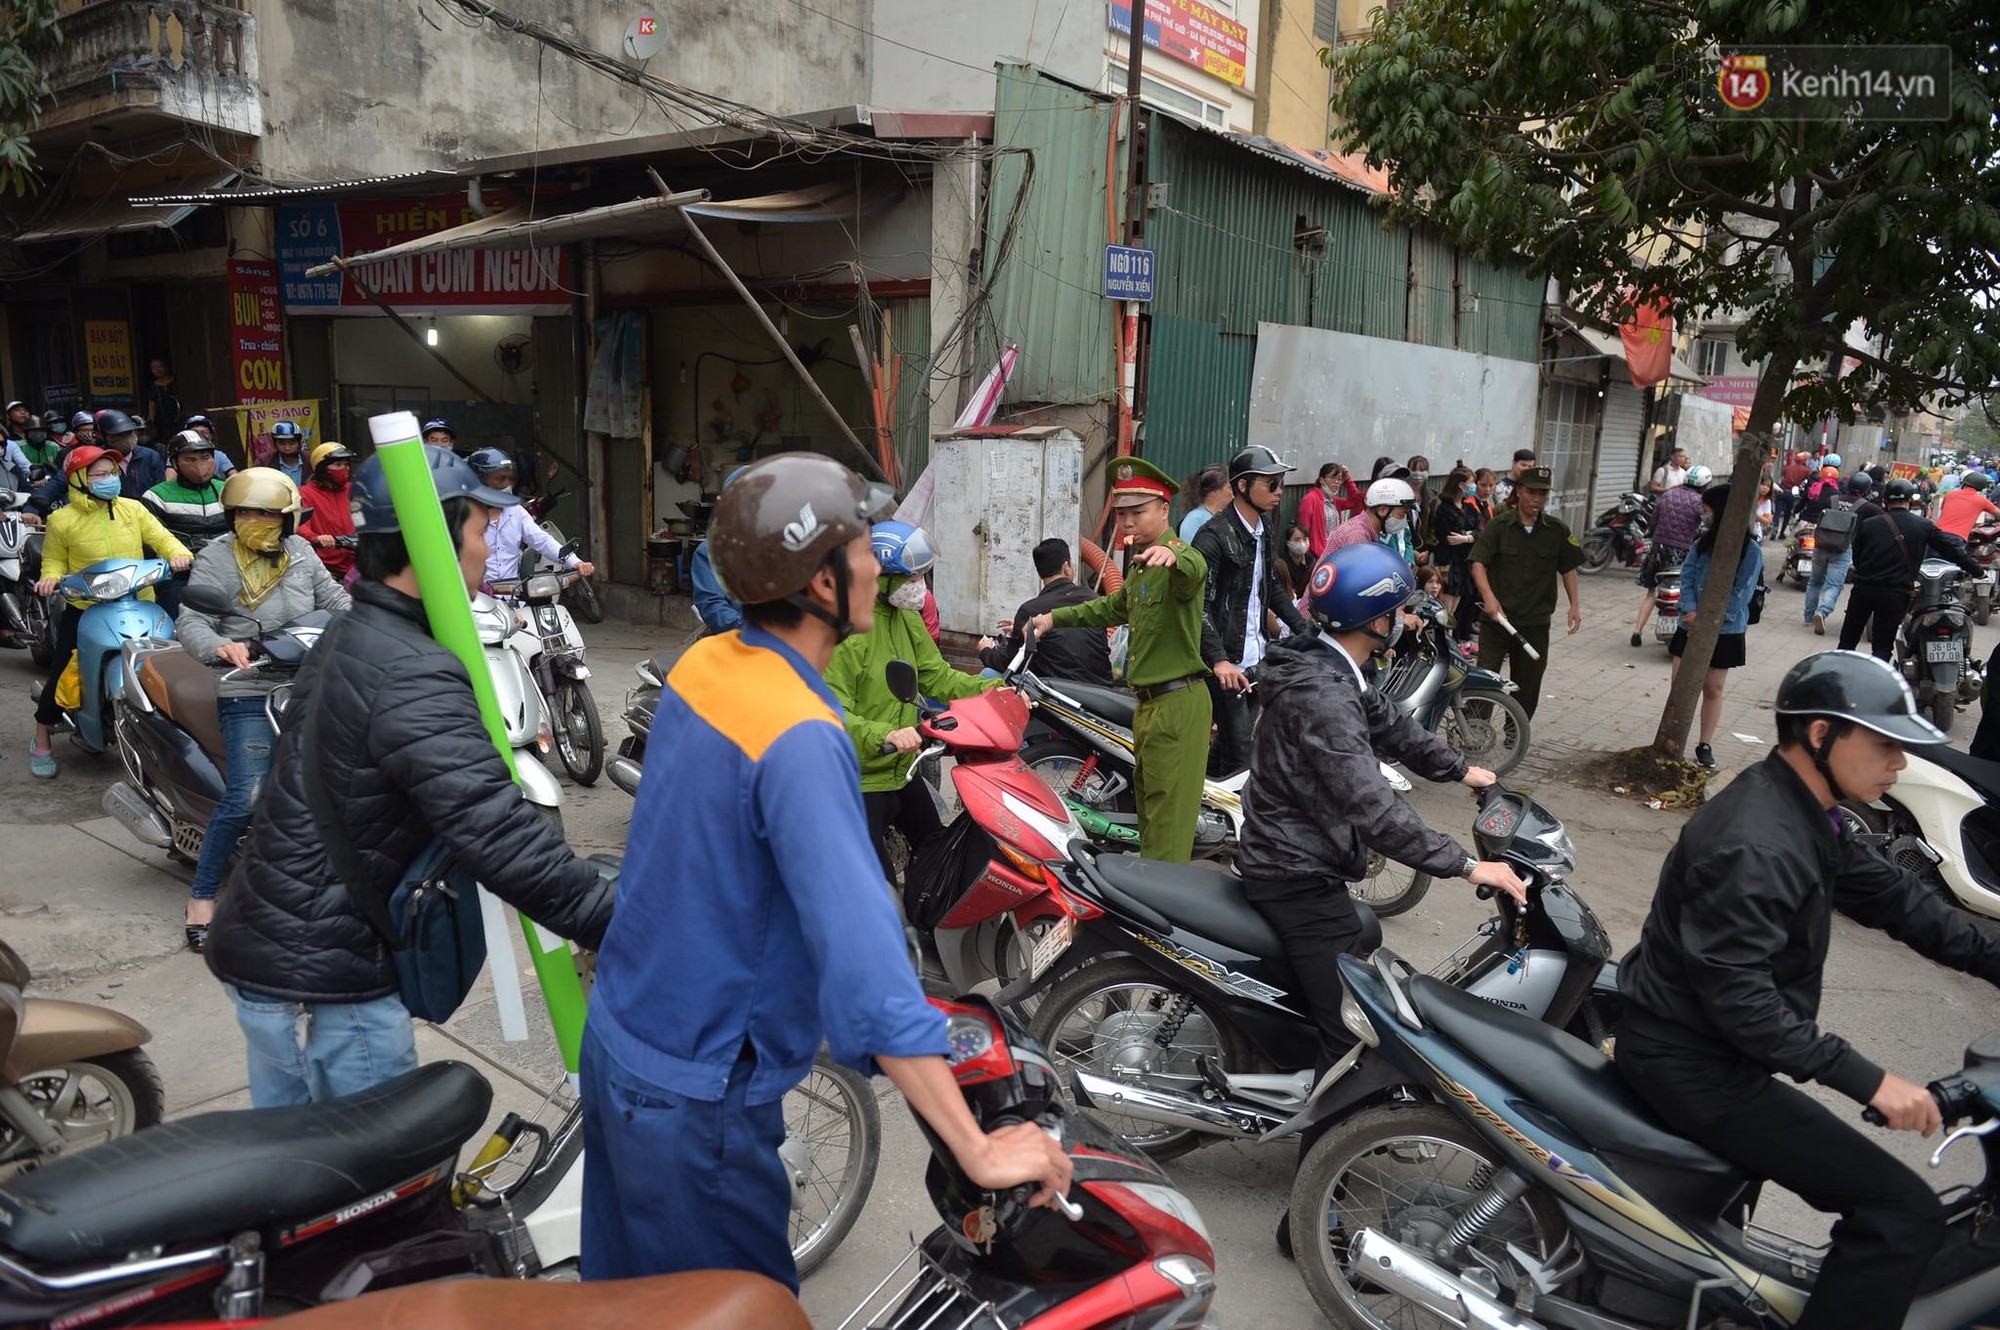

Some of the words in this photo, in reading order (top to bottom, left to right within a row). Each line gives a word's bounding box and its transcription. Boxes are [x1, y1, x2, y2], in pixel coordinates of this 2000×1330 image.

[1191, 7, 1218, 26] MÁY
[1222, 21, 1246, 40] BAY
[317, 218, 328, 237] 6
[483, 246, 561, 292] NGON
[1110, 251, 1130, 273] NGÕ
[1131, 256, 1150, 275] 116
[234, 284, 261, 326] BÚN
[240, 357, 283, 391] CƠM
[987, 874, 1024, 896] HONDA
[335, 1190, 398, 1224] HONDA
